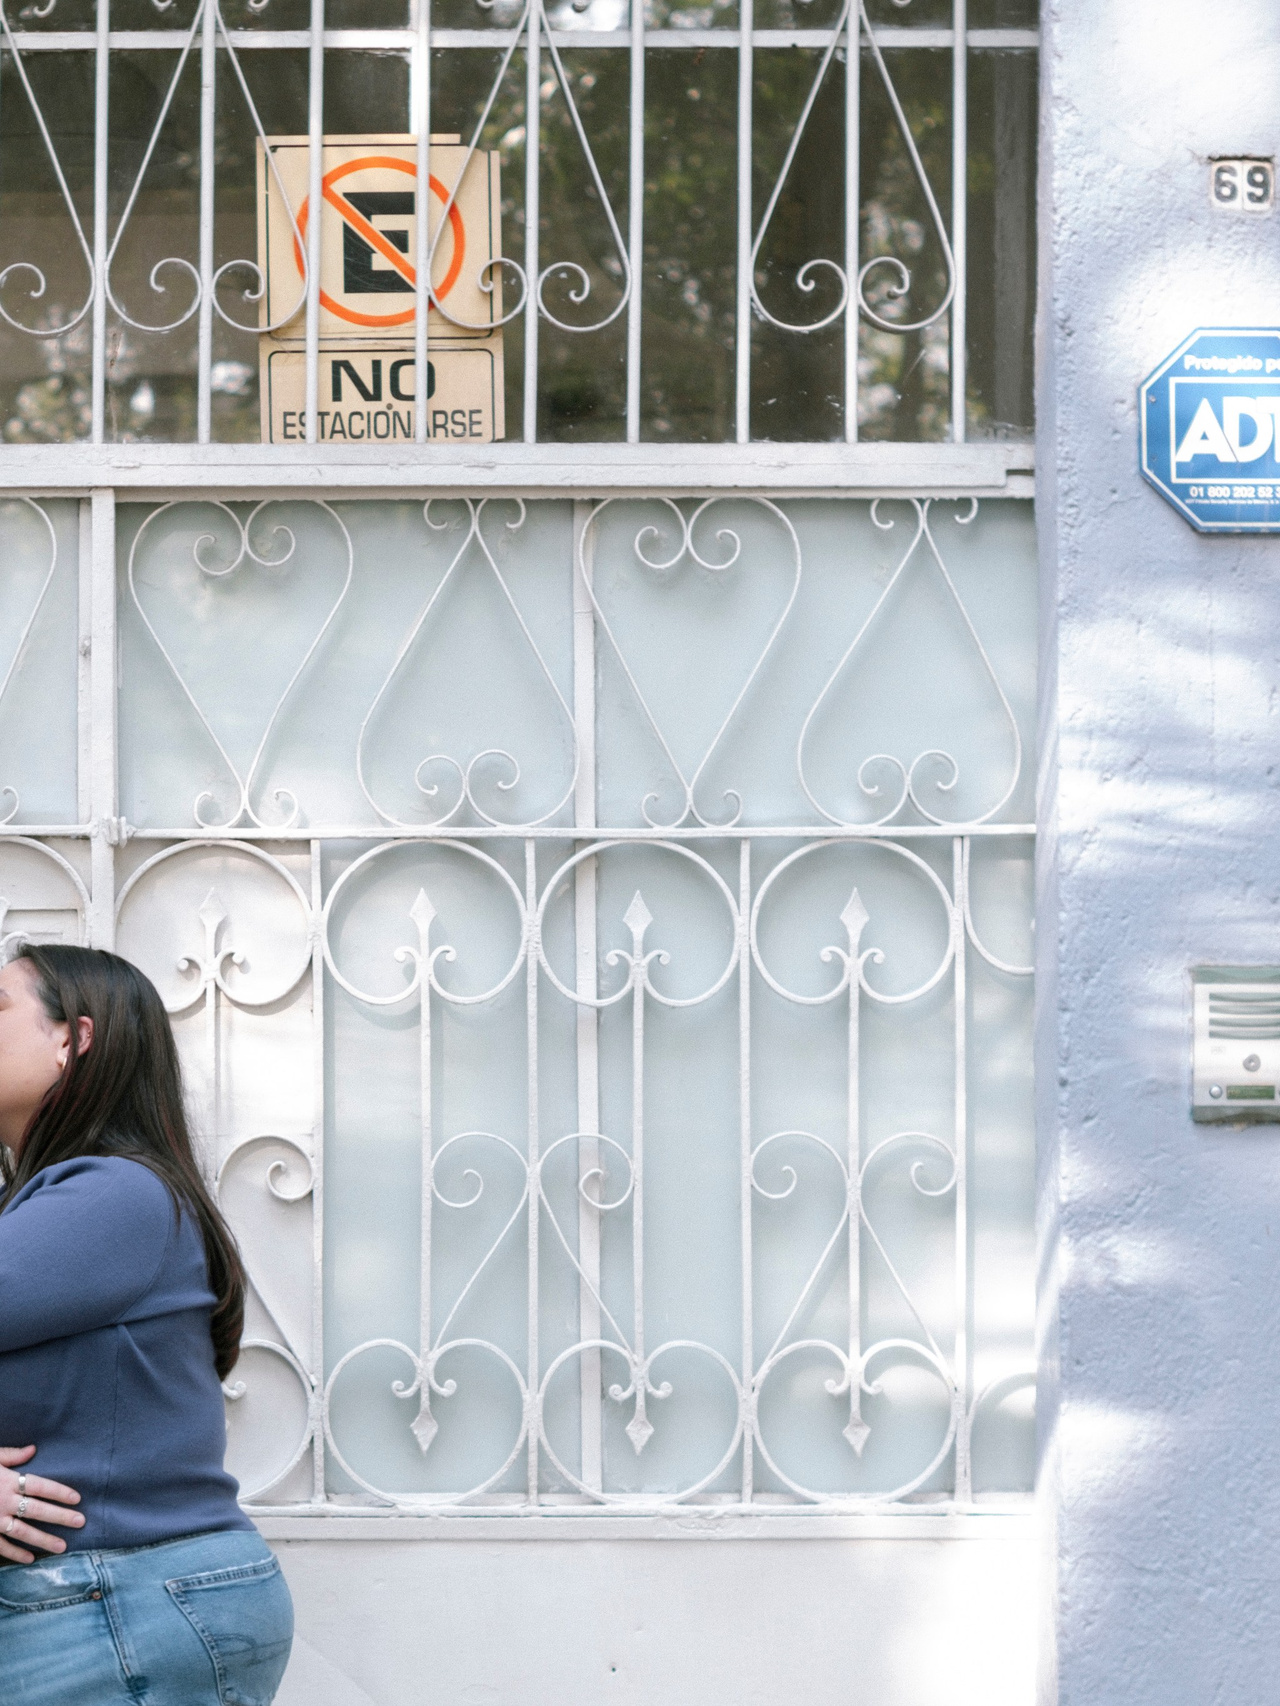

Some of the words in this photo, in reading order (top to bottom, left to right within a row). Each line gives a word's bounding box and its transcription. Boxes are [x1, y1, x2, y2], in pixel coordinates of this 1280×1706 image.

[1214, 165, 1270, 203] 69
[343, 191, 418, 293] E
[331, 359, 435, 402] NO
[1184, 354, 1263, 373] Protegido
[282, 409, 483, 440] ETACIONRSE
[1190, 486, 1204, 498] 01
[1208, 486, 1230, 498] 800
